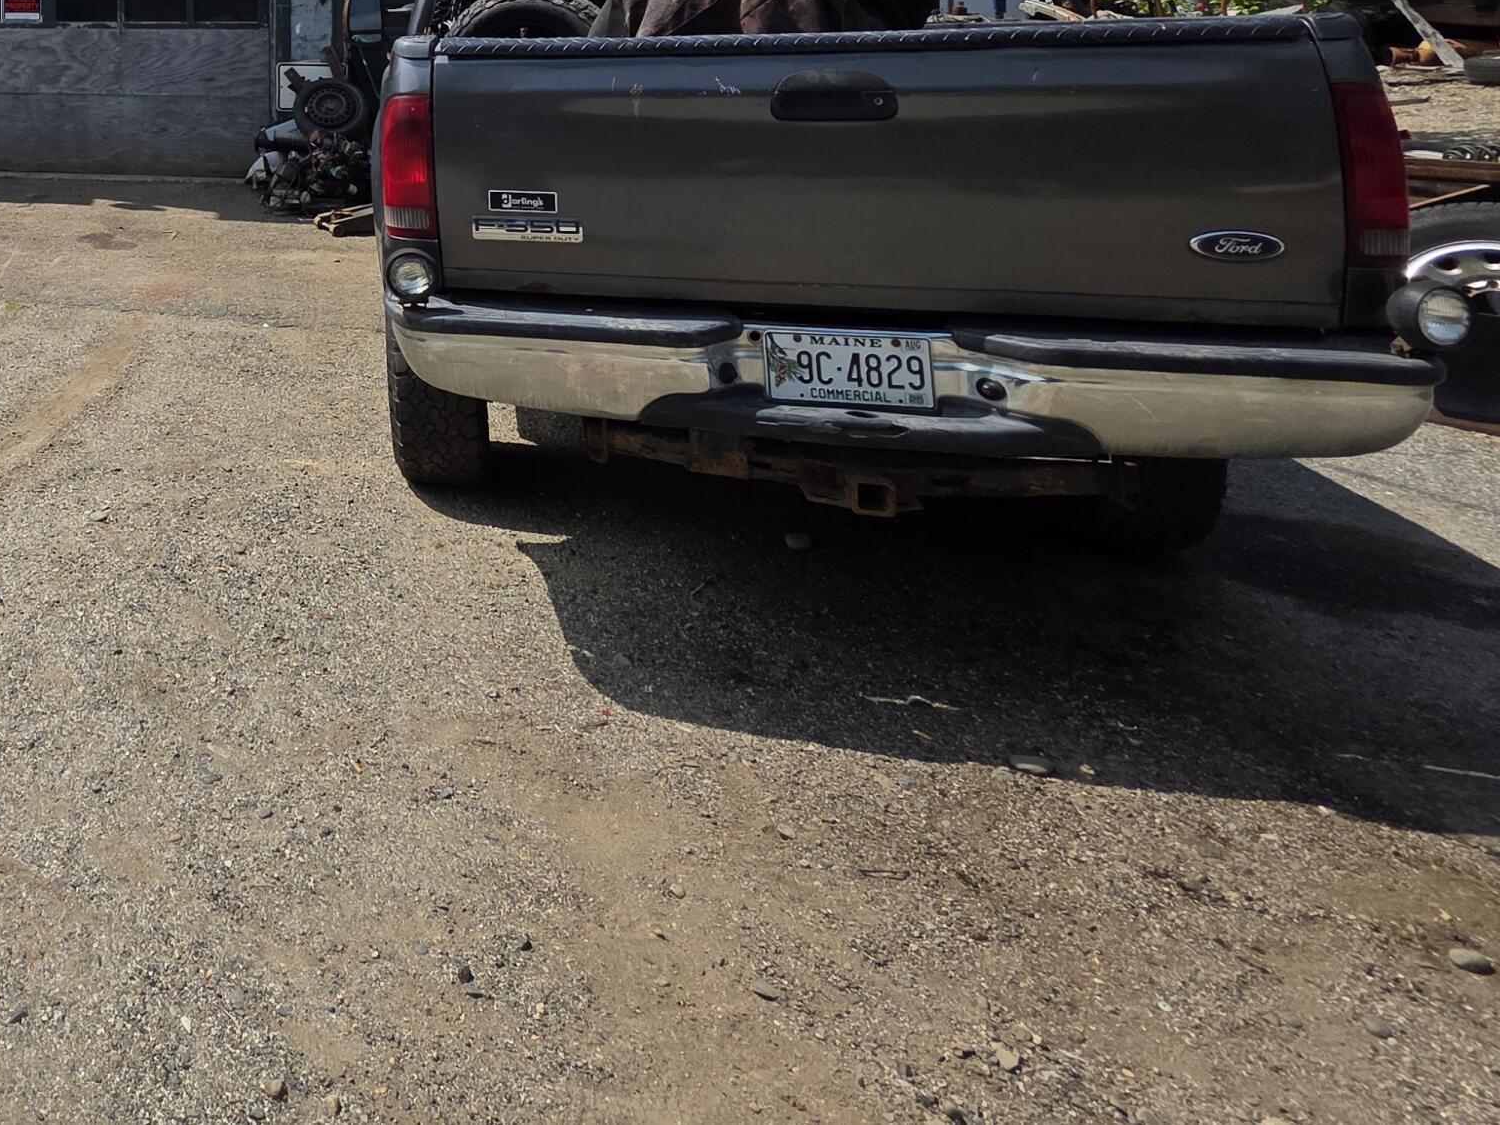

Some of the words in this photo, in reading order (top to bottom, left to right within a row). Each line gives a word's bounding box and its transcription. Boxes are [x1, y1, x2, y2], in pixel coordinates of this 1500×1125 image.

[1214, 236, 1263, 254] Ford
[809, 335, 883, 349] MAINE
[904, 340, 921, 351] AUG
[809, 387, 893, 404] COMMERCIAL
